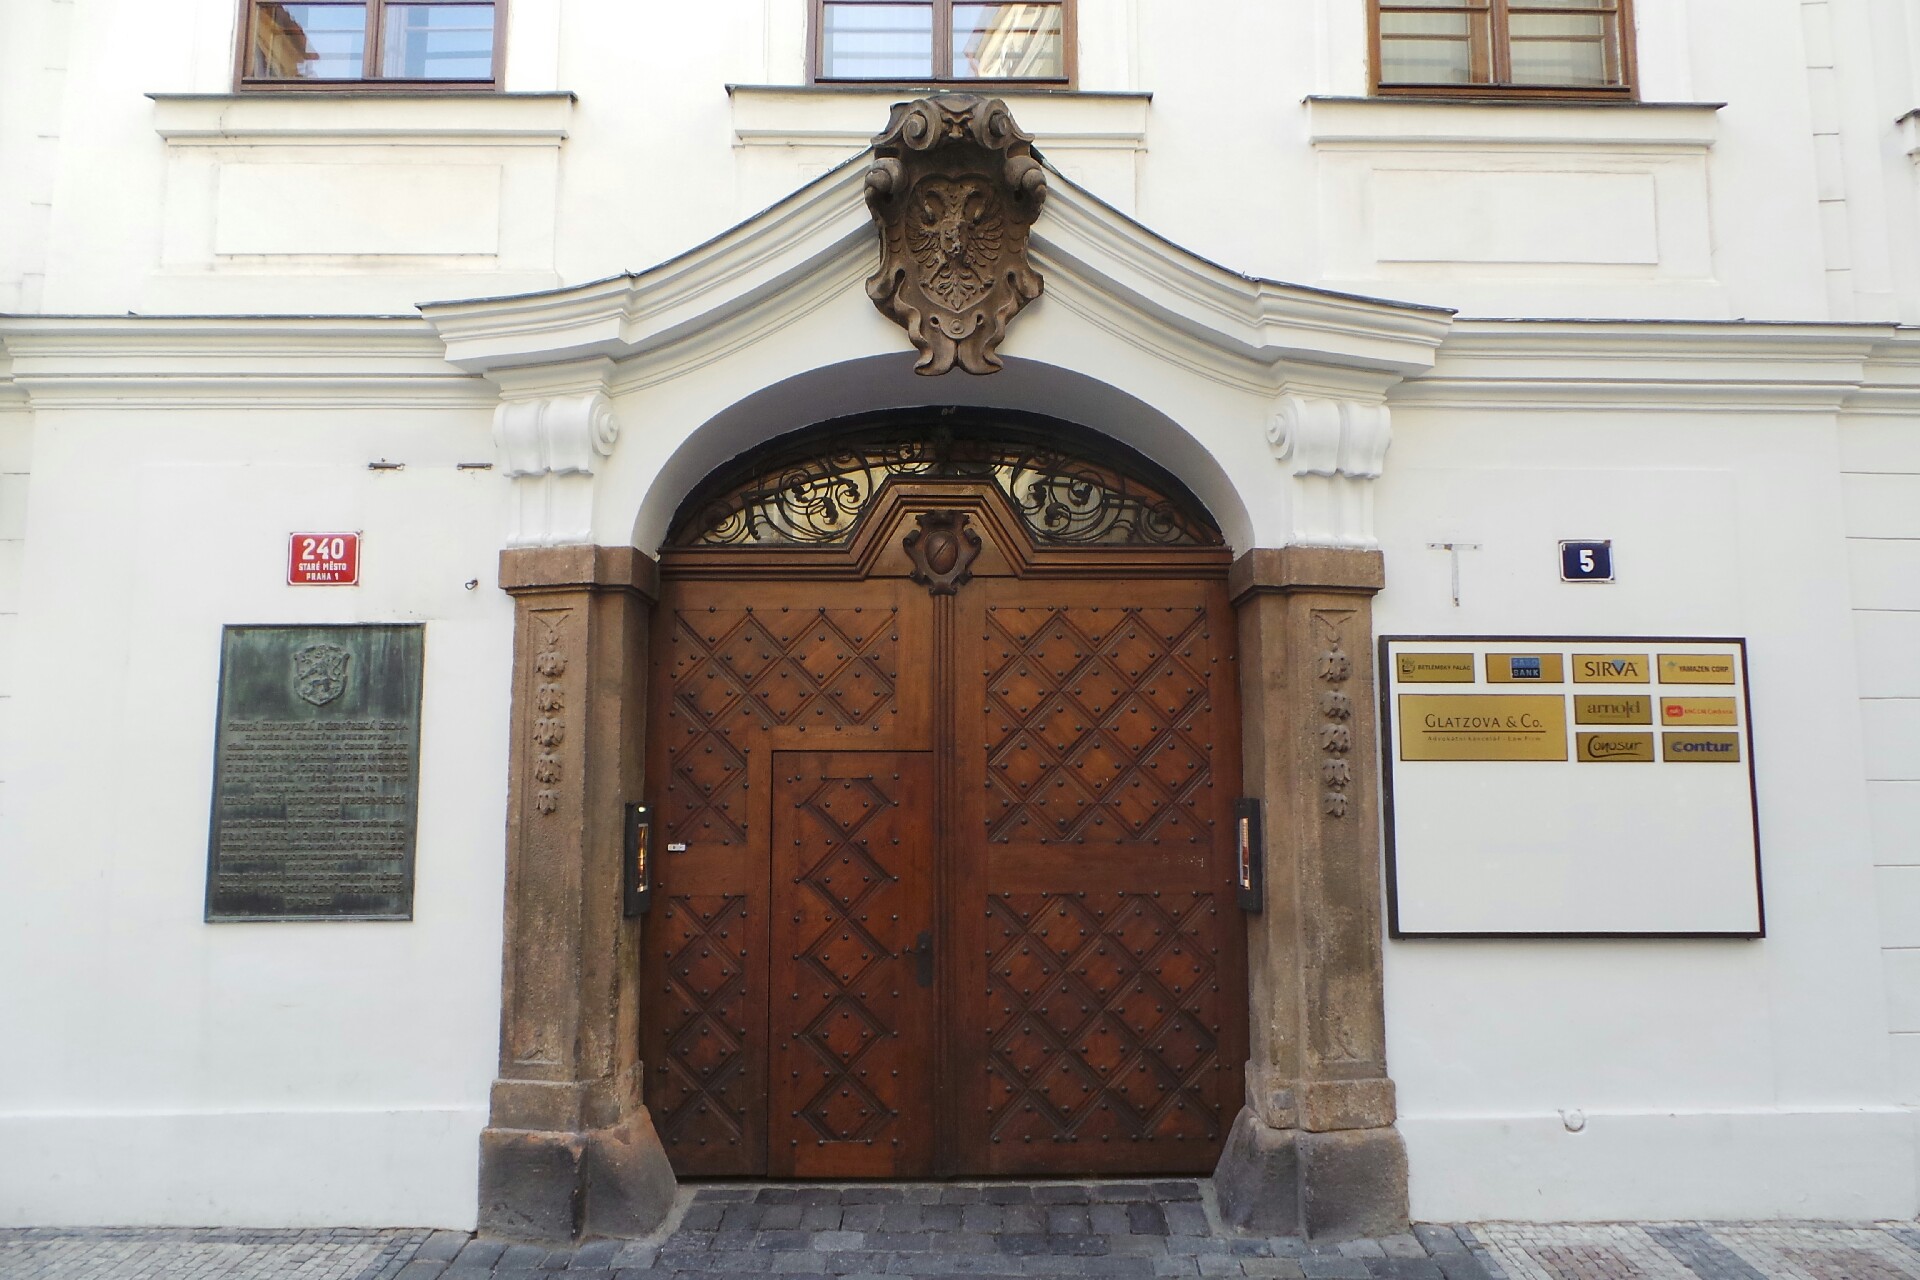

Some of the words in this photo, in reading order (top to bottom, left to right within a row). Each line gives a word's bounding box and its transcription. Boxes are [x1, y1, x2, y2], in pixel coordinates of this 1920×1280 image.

[302, 538, 344, 560] 240
[298, 561, 320, 571] STARÉ
[322, 560, 347, 571] MĚSTO
[1580, 549, 1594, 572] 5
[306, 572, 331, 581] PRAHA
[334, 572, 339, 581] 1
[1585, 661, 1639, 677] SIRVA
[1587, 701, 1640, 718] arnold
[1425, 713, 1500, 728] GLATZOVA
[1506, 715, 1517, 728] &
